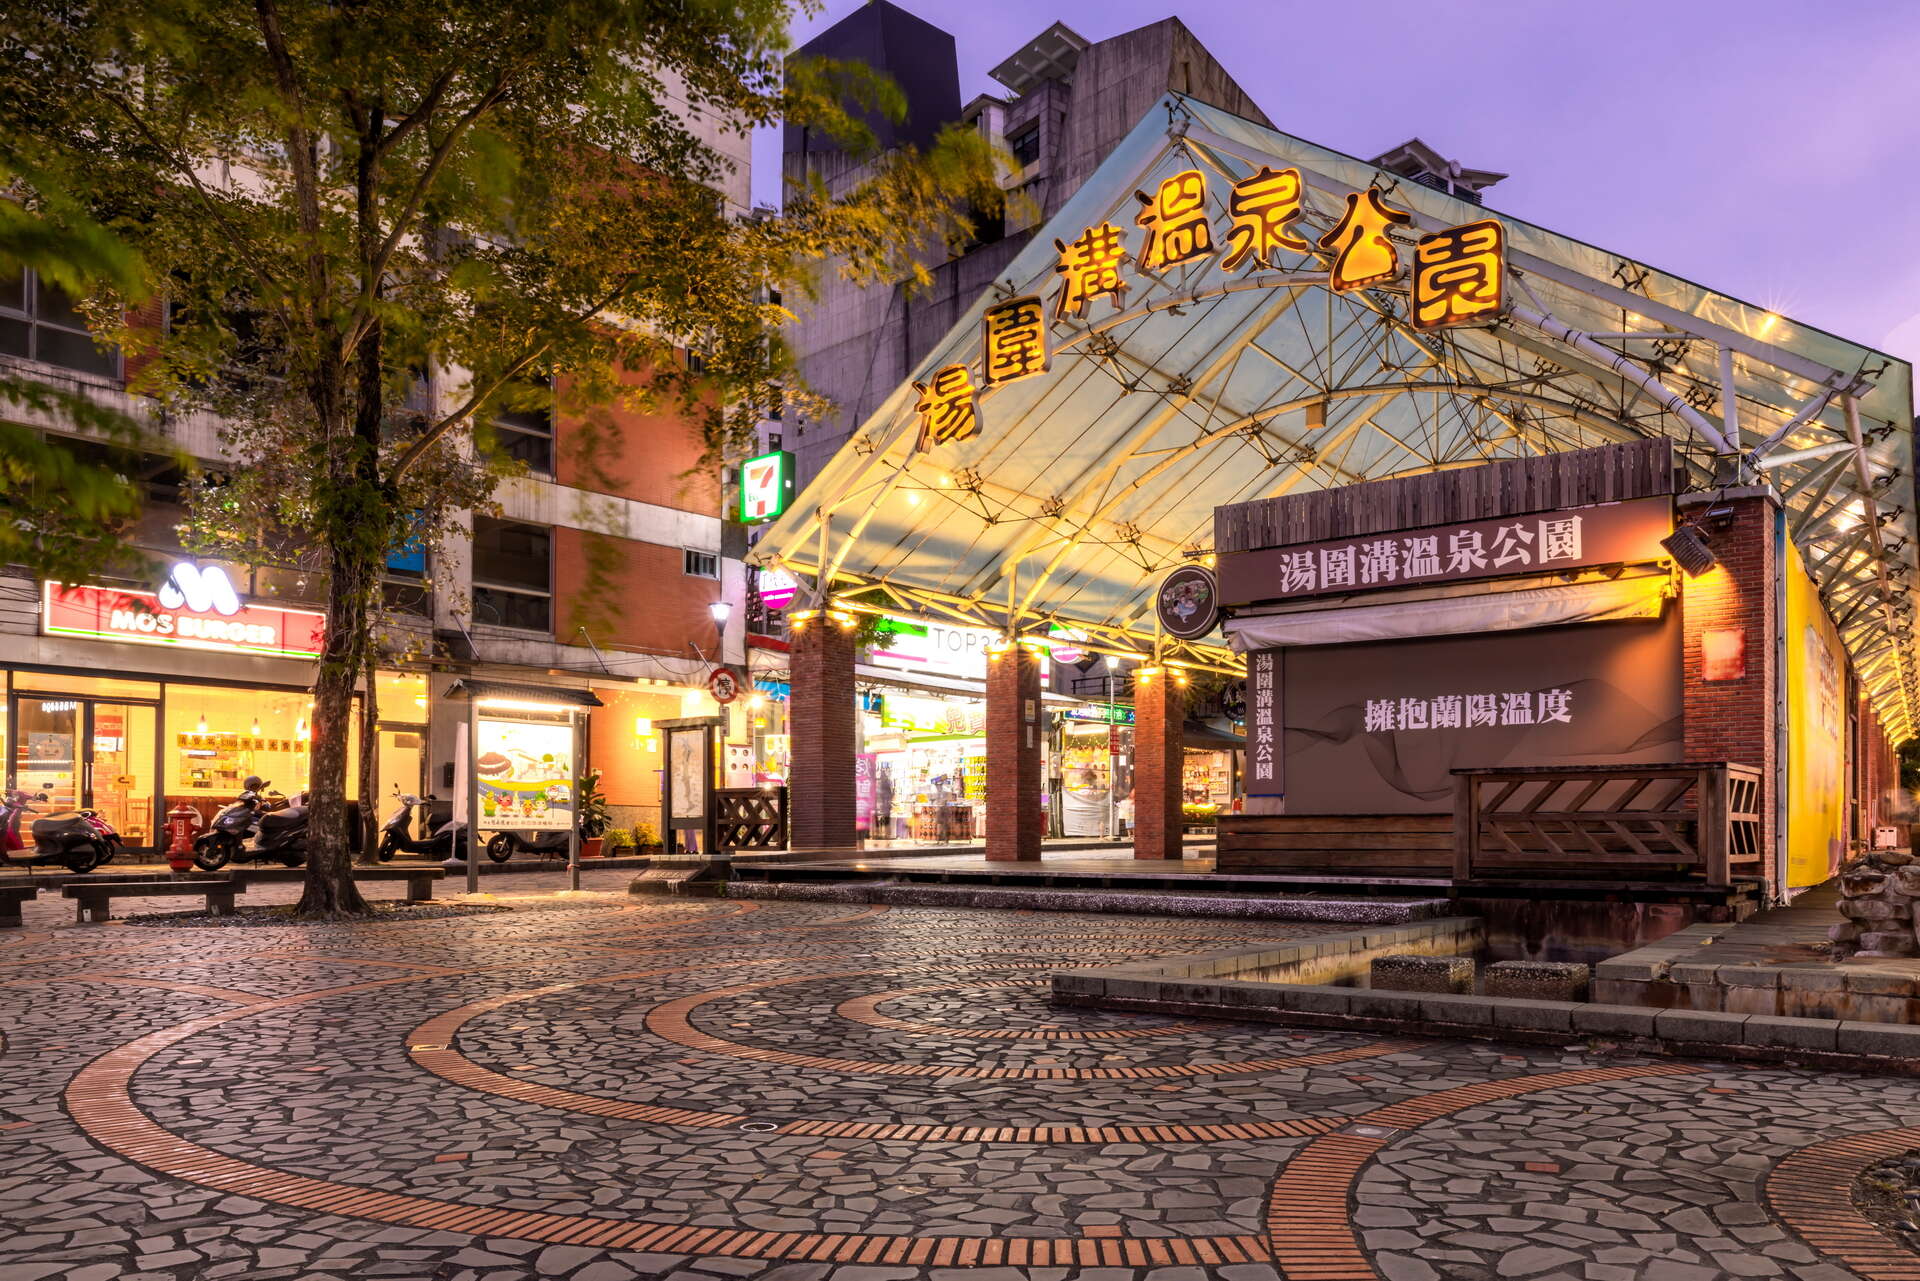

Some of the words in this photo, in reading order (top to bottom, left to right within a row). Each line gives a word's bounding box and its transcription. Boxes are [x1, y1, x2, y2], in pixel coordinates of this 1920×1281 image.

[912, 165, 1507, 455] 湯圍溝溫泉公園
[1280, 515, 1583, 593] 湯圍溝溫泉公園
[110, 609, 174, 634] MOS
[177, 616, 276, 645] BURGER
[716, 678, 732, 696] 停
[1255, 653, 1274, 781] 湯圍溝溫泉公園
[1364, 688, 1574, 733] 擁抱蘭陽溫度
